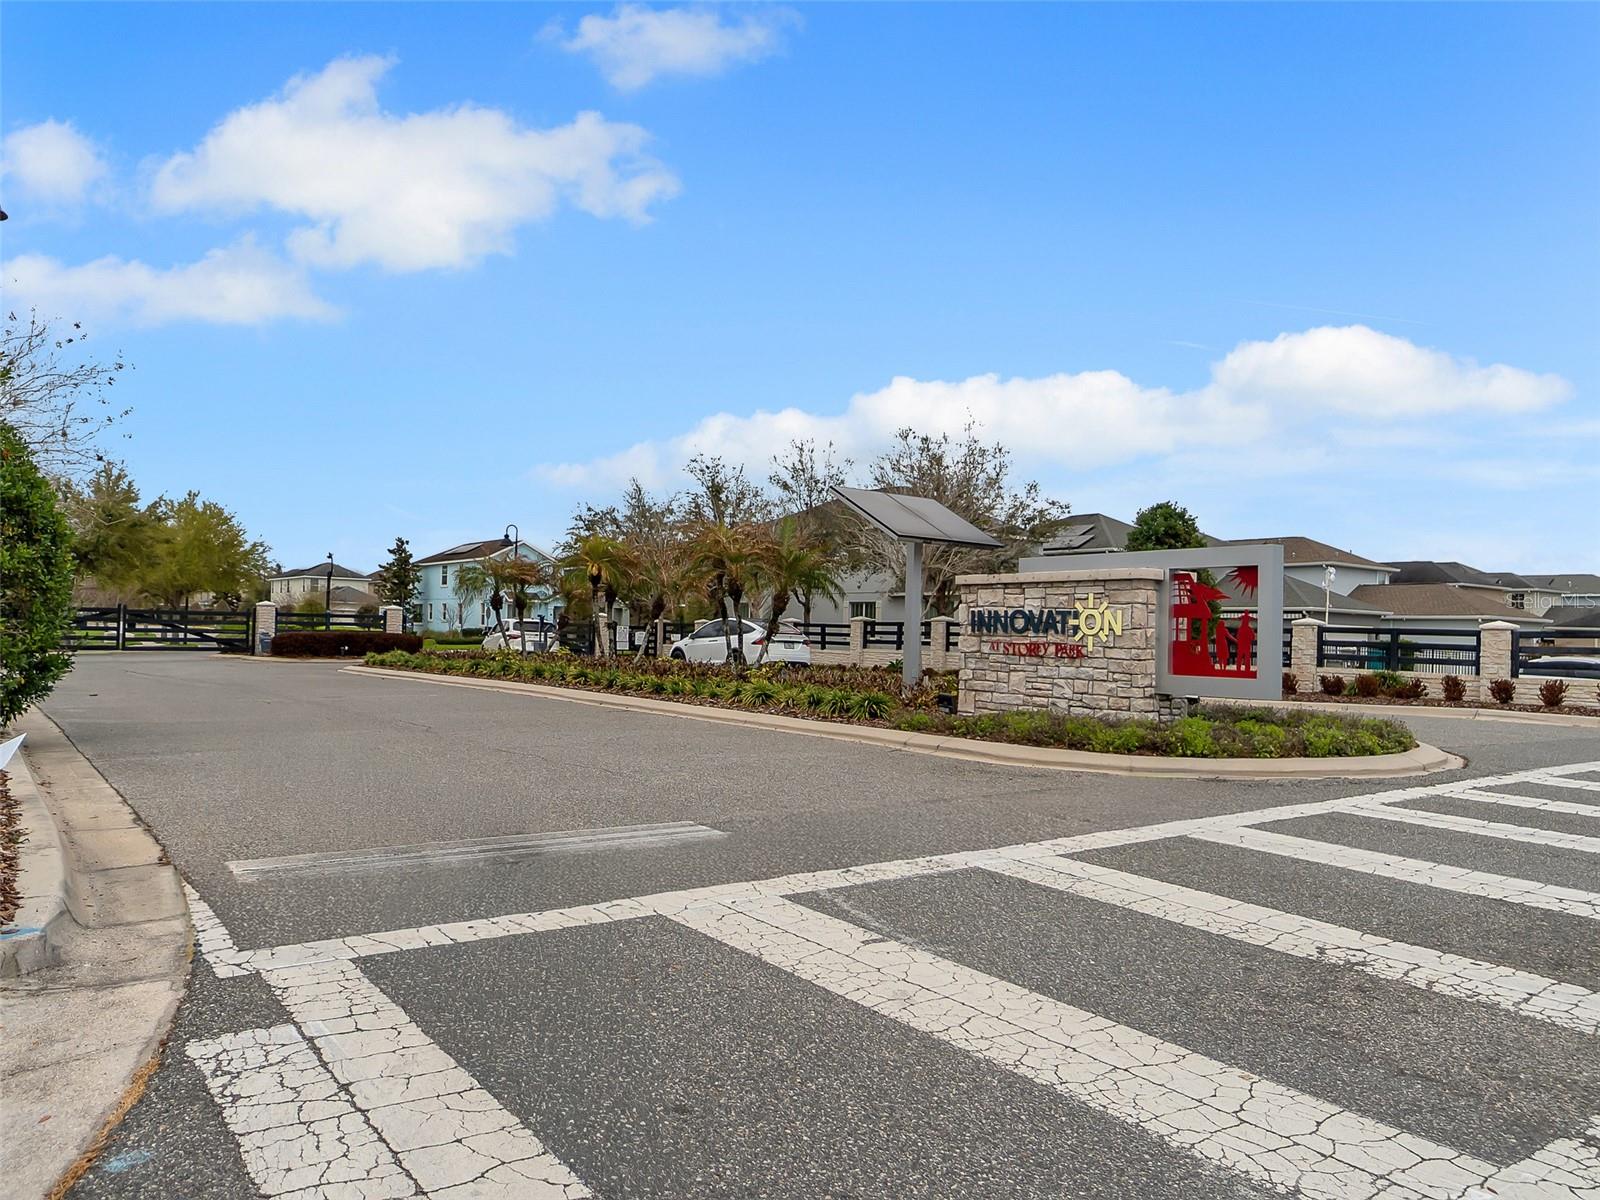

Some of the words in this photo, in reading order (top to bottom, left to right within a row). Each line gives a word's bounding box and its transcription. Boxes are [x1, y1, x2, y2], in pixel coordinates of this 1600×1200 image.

[970, 608, 1122, 637] INNOVATION
[1003, 642, 1049, 657] STOREY
[1054, 644, 1085, 659] PARK
